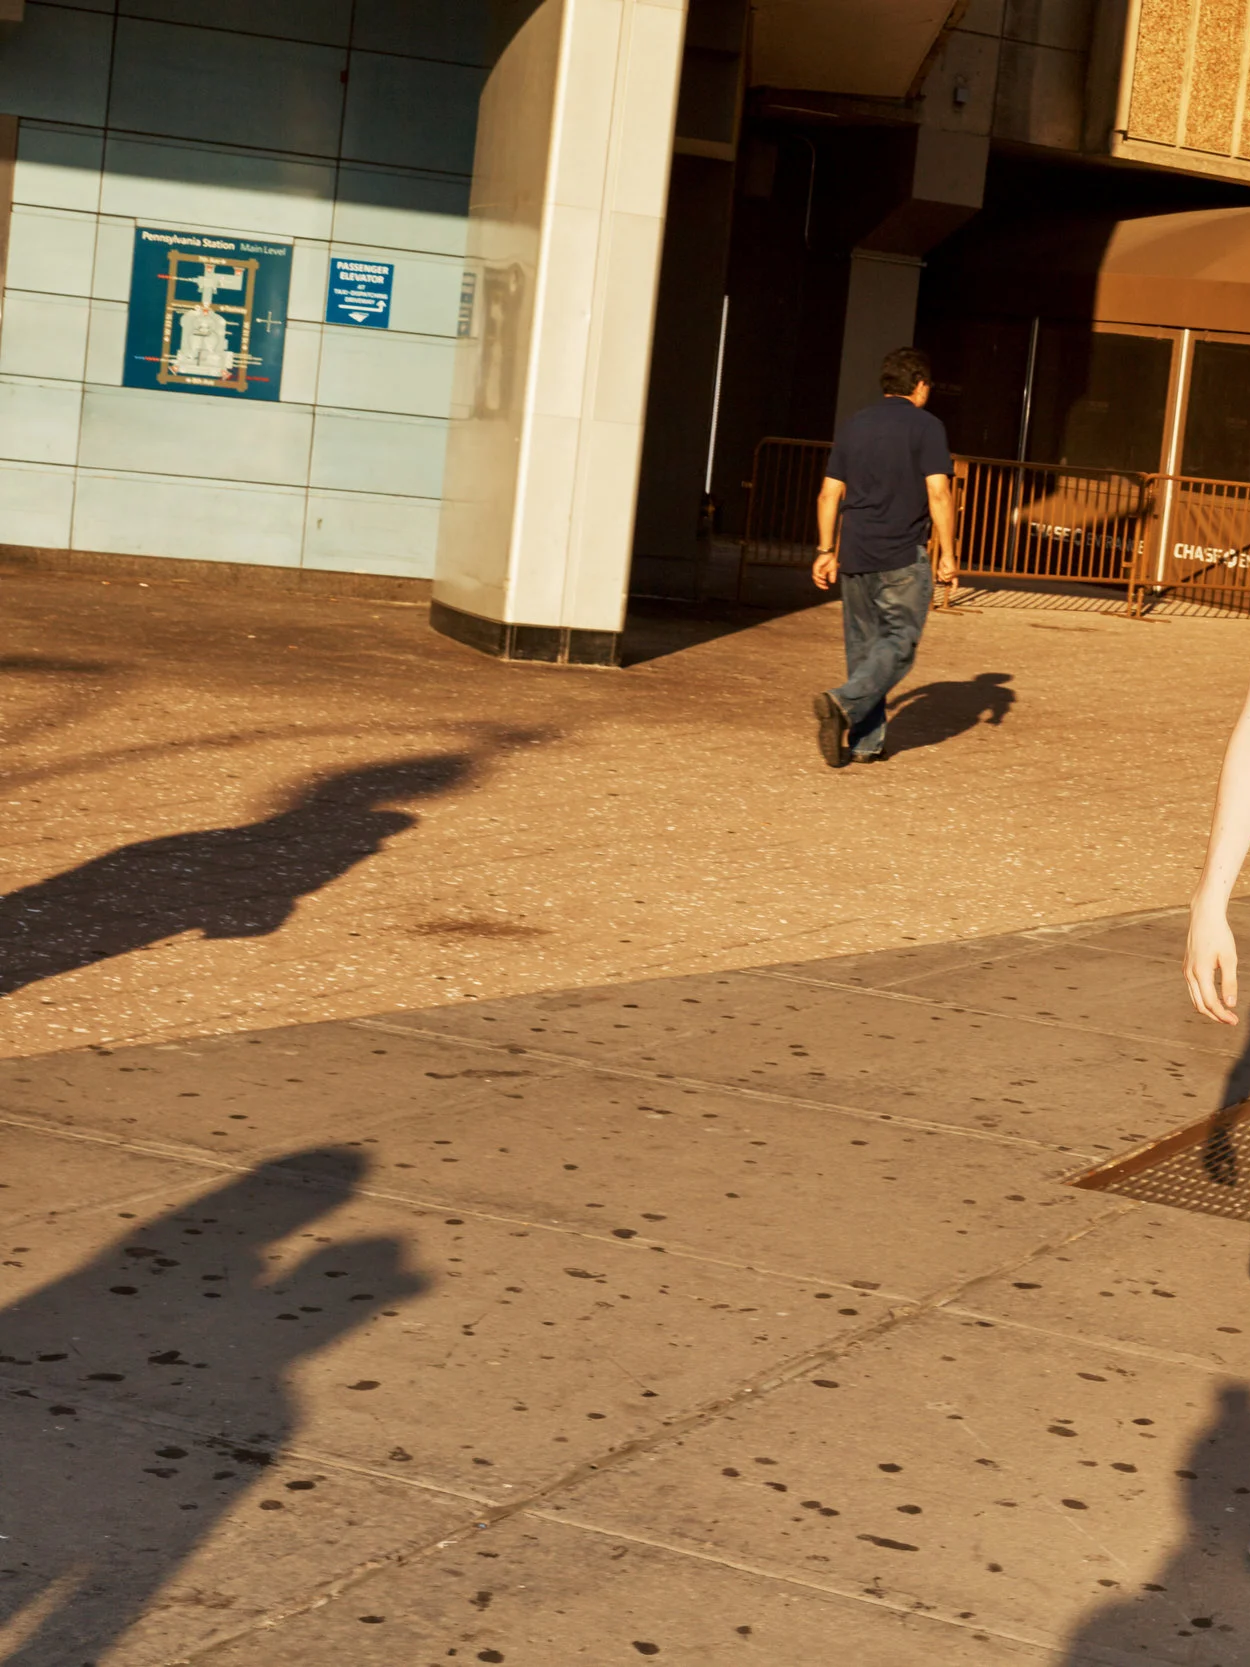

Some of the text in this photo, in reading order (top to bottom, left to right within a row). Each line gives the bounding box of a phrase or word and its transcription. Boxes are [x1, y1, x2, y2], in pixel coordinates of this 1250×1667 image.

[142, 231, 235, 250] Pennsylvania Station
[240, 243, 286, 256] Main Level
[336, 261, 389, 275] PASSENGER
[339, 271, 384, 284] ELEVATOR
[1173, 542, 1223, 563] CHASE
